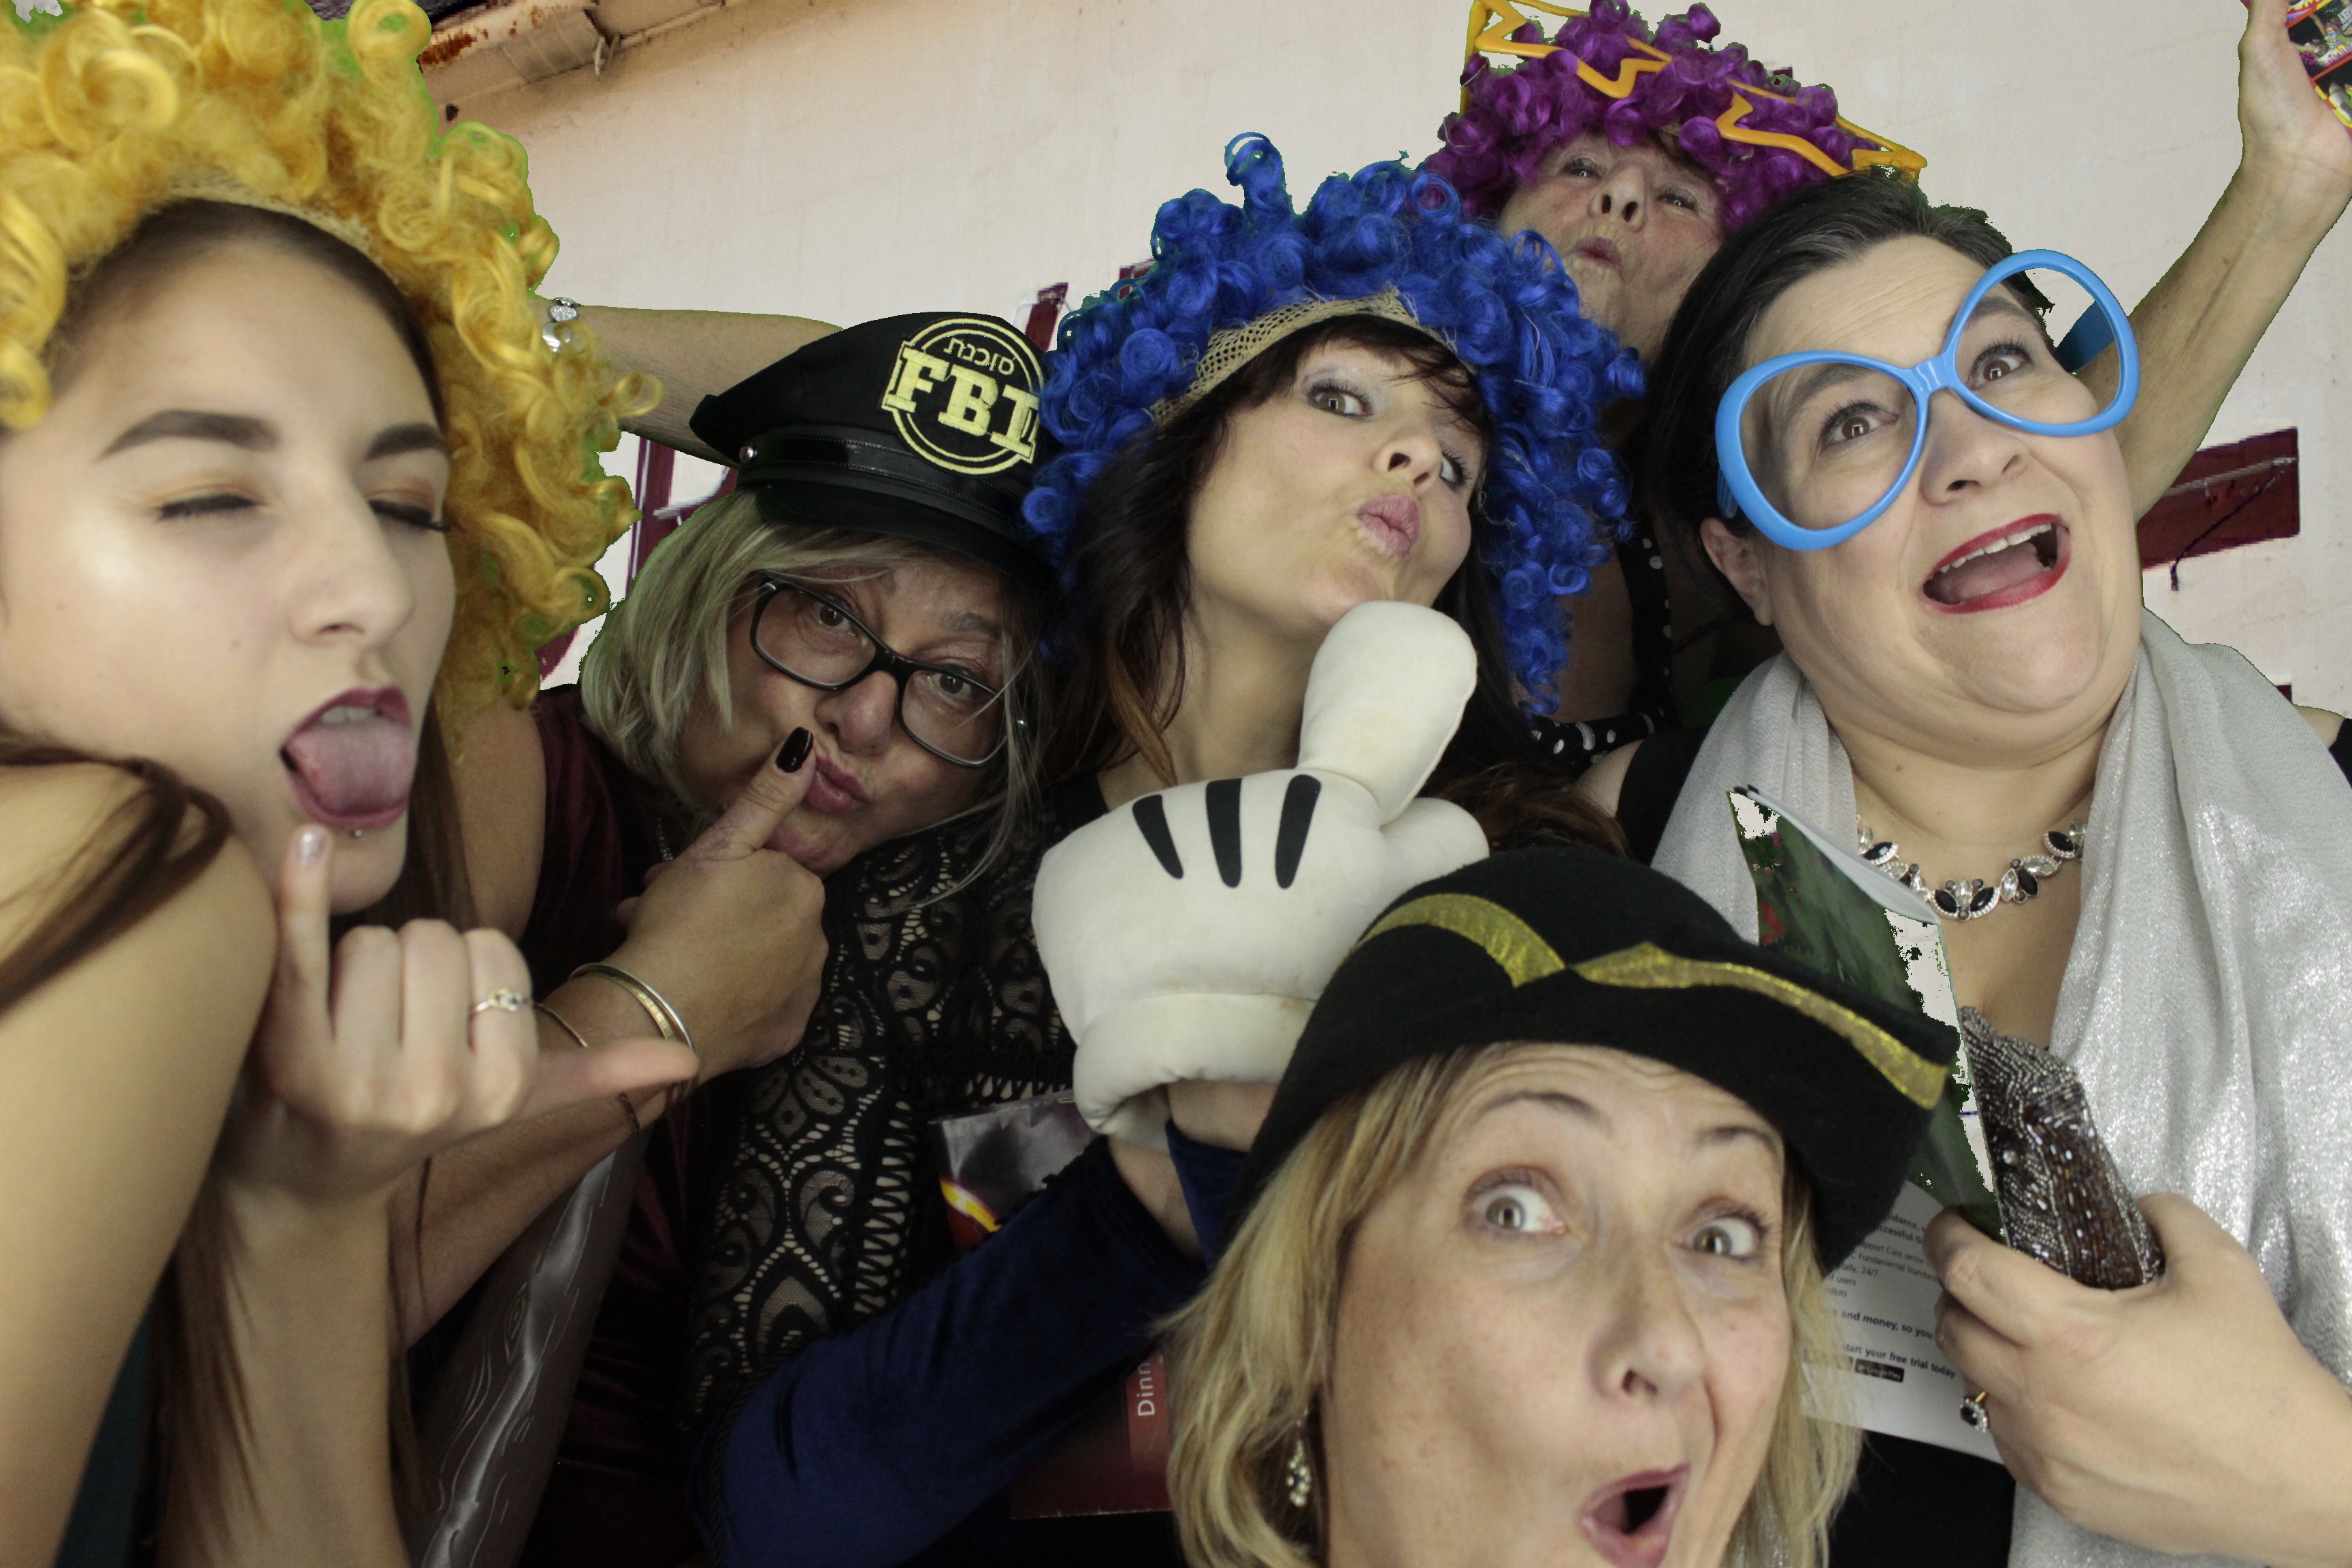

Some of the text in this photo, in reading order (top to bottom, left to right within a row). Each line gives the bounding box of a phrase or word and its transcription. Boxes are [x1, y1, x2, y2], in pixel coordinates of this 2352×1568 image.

[943, 337, 1015, 376] סוכנת
[885, 346, 1040, 458] FBI
[1887, 1213, 1919, 1231] idance,
[1878, 1225, 1913, 1241] ccessful
[1863, 1242, 1884, 1252] pport
[1886, 1246, 1903, 1258] Care
[1859, 1252, 1905, 1271] Fundamental
[1837, 1277, 1857, 1286] users
[1861, 1267, 1878, 1277] 24/7
[1841, 1311, 1861, 1322] and
[1863, 1316, 1898, 1331] money,
[1901, 1325, 1913, 1334] so
[1915, 1328, 1933, 1339] you
[1843, 1343, 1955, 1379] tart your free trial today
[1136, 1362, 1156, 1416] Dinn
